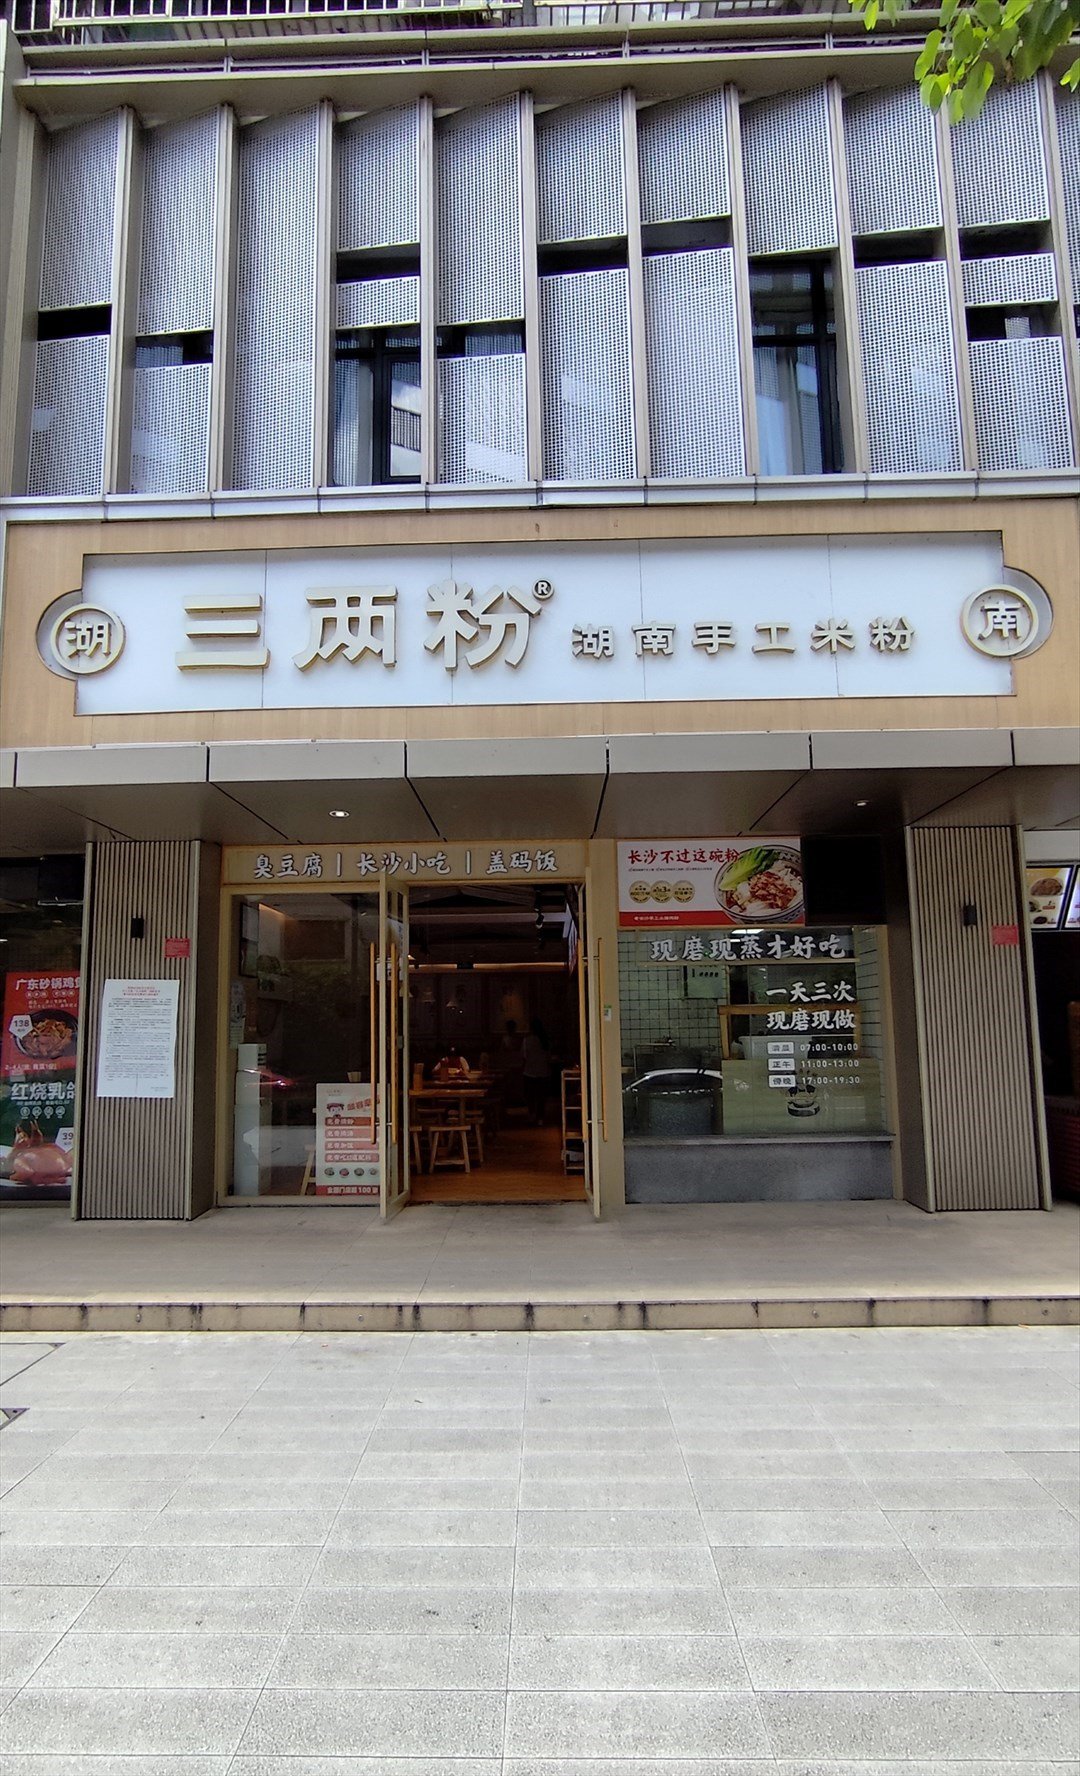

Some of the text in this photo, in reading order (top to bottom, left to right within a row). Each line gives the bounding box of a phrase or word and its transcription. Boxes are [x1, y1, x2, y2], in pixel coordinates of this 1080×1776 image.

[175, 579, 542, 672] 三两粉
[977, 601, 1022, 640] 南
[64, 620, 111, 659] 湖
[571, 615, 916, 659] 湖南手工米粉
[253, 849, 559, 880] 臭豆腐 长沙小吃 盖码饭
[628, 847, 740, 865] 长沙不过这碗粉
[650, 933, 846, 962] 现磨现蒸才好吃
[765, 980, 856, 1002] 一天三次
[766, 1007, 857, 1031] 现磨现做
[800, 1043, 859, 1052] 07:00-10:00
[771, 1059, 860, 1069] 正午 11:00-13:00
[801, 1076, 861, 1085] 17:00-19:30
